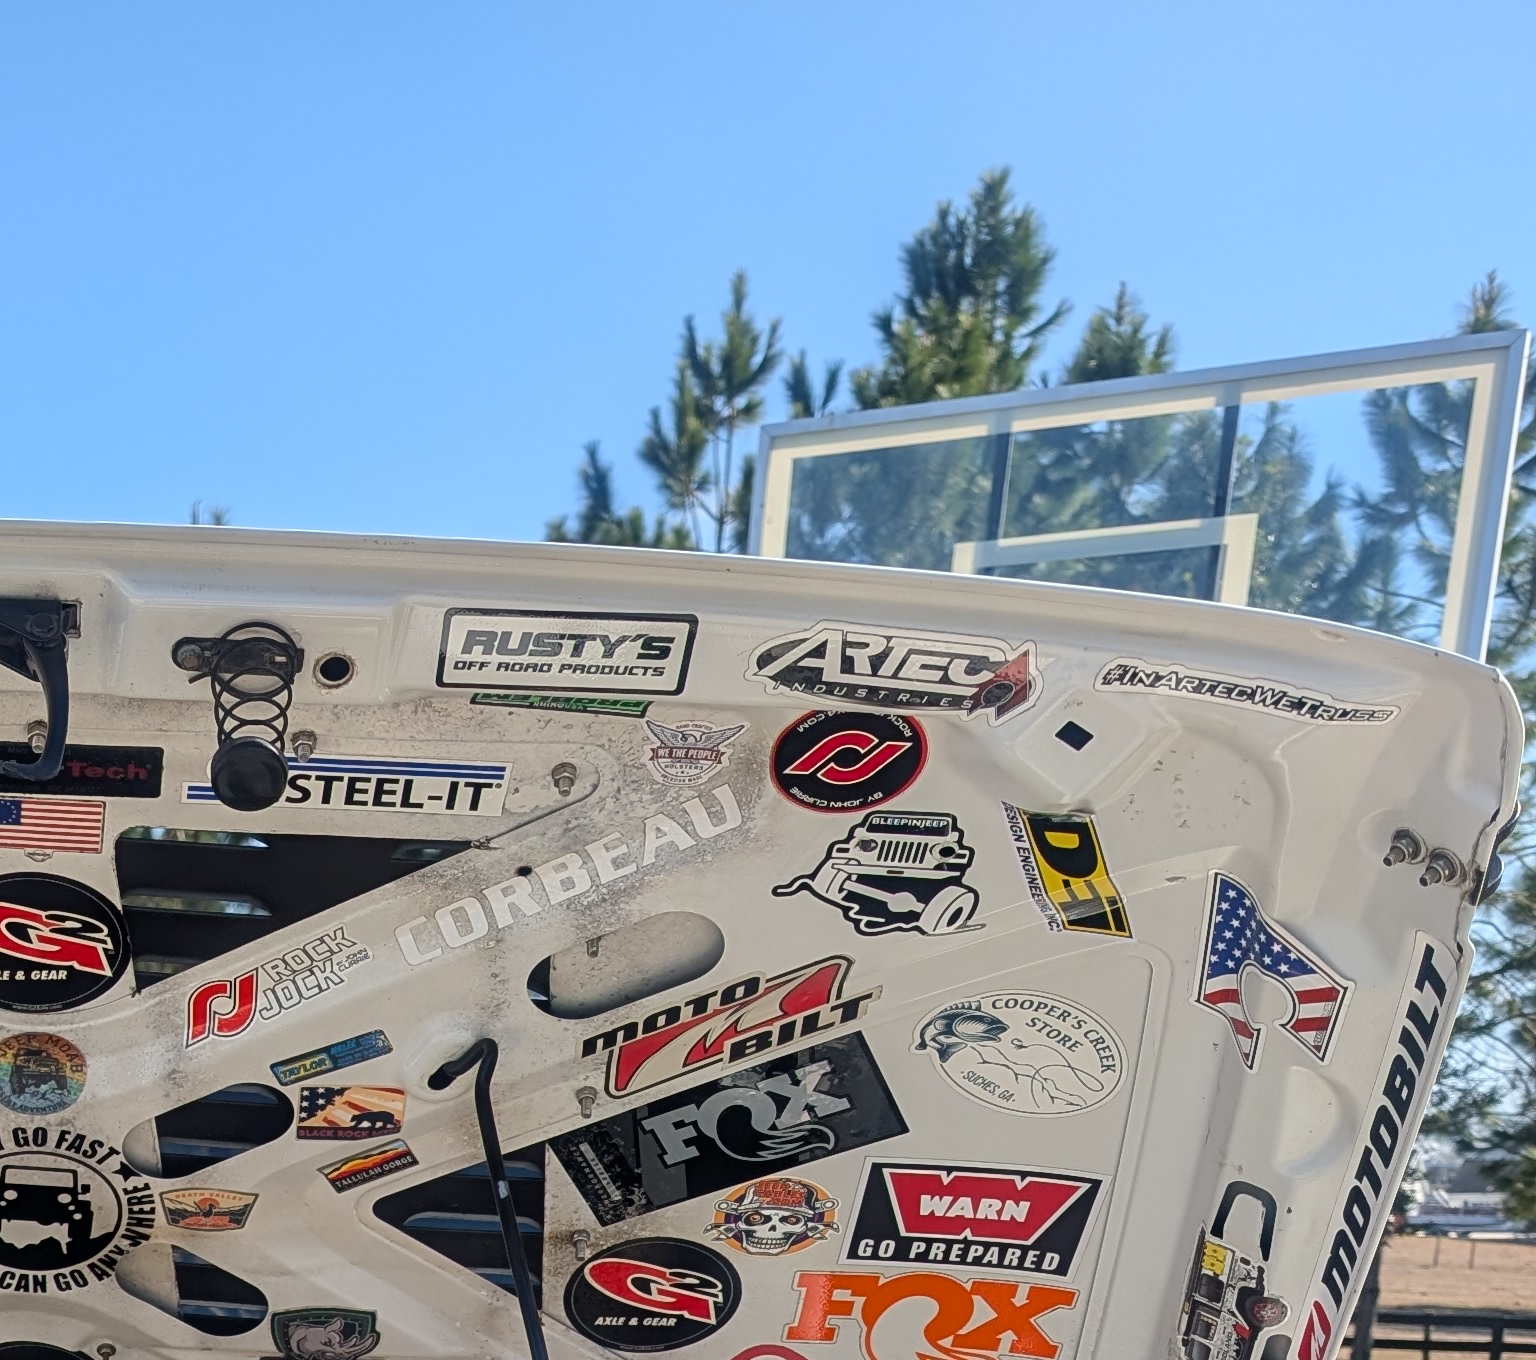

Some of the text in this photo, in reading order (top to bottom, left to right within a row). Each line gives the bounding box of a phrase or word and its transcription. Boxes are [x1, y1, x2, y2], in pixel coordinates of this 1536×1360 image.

[460, 629, 676, 660] RUSTY'S
[758, 628, 1007, 693] ARTEC
[452, 659, 666, 677] OFF ROAD PRODUCTS
[774, 681, 974, 709] INDUSTRIES
[658, 748, 718, 760] WE THE PEOPLE
[286, 773, 495, 812] STEEL-IT
[790, 786, 863, 808] JOHN CURRIE
[872, 816, 948, 829] BLEEPINJEEP
[395, 784, 744, 966] CORBEAU
[261, 926, 358, 983] ROCK
[337, 952, 371, 973] CURRIE
[344, 947, 368, 963] JOHN
[14, 970, 26, 981] &
[30, 970, 68, 981] GEAR
[259, 957, 345, 1021] JOCK
[727, 991, 875, 1065] BILT
[991, 998, 1117, 1074] COOPER'S CREEK
[1025, 1016, 1084, 1053] STORE
[44, 1035, 84, 1073] MOAB
[963, 1070, 998, 1096] SUCHES,
[642, 1060, 852, 1165] FOX
[1319, 942, 1448, 1313] MOTOBILT
[11, 1126, 49, 1148] GO
[54, 1128, 121, 1166] FAST
[299, 1129, 334, 1138] BLACK
[334, 1165, 382, 1189] TALLULAH
[175, 1191, 245, 1202] DEATH VALLEY
[919, 1194, 1031, 1223] WARN
[54, 1269, 89, 1292] GO
[87, 1182, 157, 1283] ANYWHERE
[857, 1238, 1062, 1271] GO PREPARED
[583, 1257, 723, 1325] G2
[594, 1316, 678, 1328] AXLE & GEAR
